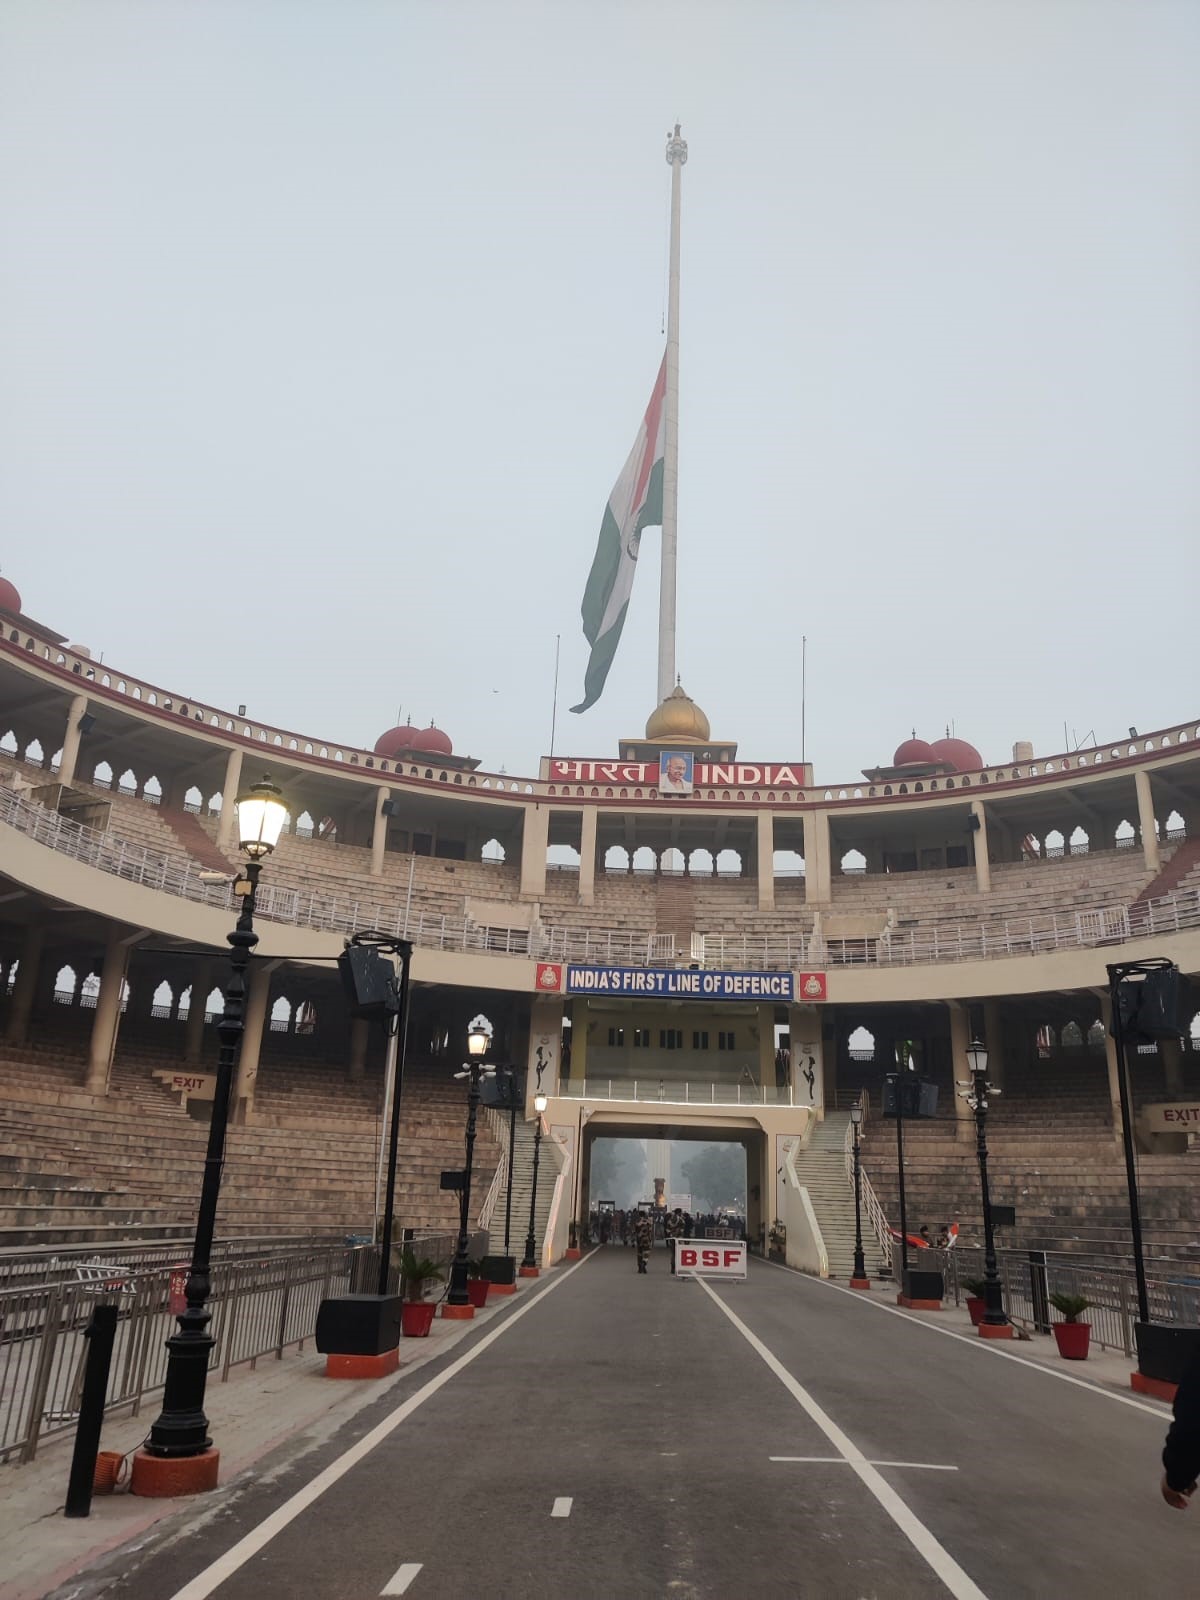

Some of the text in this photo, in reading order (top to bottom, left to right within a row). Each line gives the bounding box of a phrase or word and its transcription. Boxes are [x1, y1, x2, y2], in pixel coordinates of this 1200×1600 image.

[555, 761, 650, 782] भारत
[701, 764, 799, 785] INDIA
[570, 970, 790, 995] INDIA'S FIRST LINE OF DEFENCE
[173, 1076, 205, 1089] EXIT
[1163, 1108, 1200, 1121] EXIT
[706, 1228, 732, 1238] BSF
[680, 1249, 741, 1267] BSF
